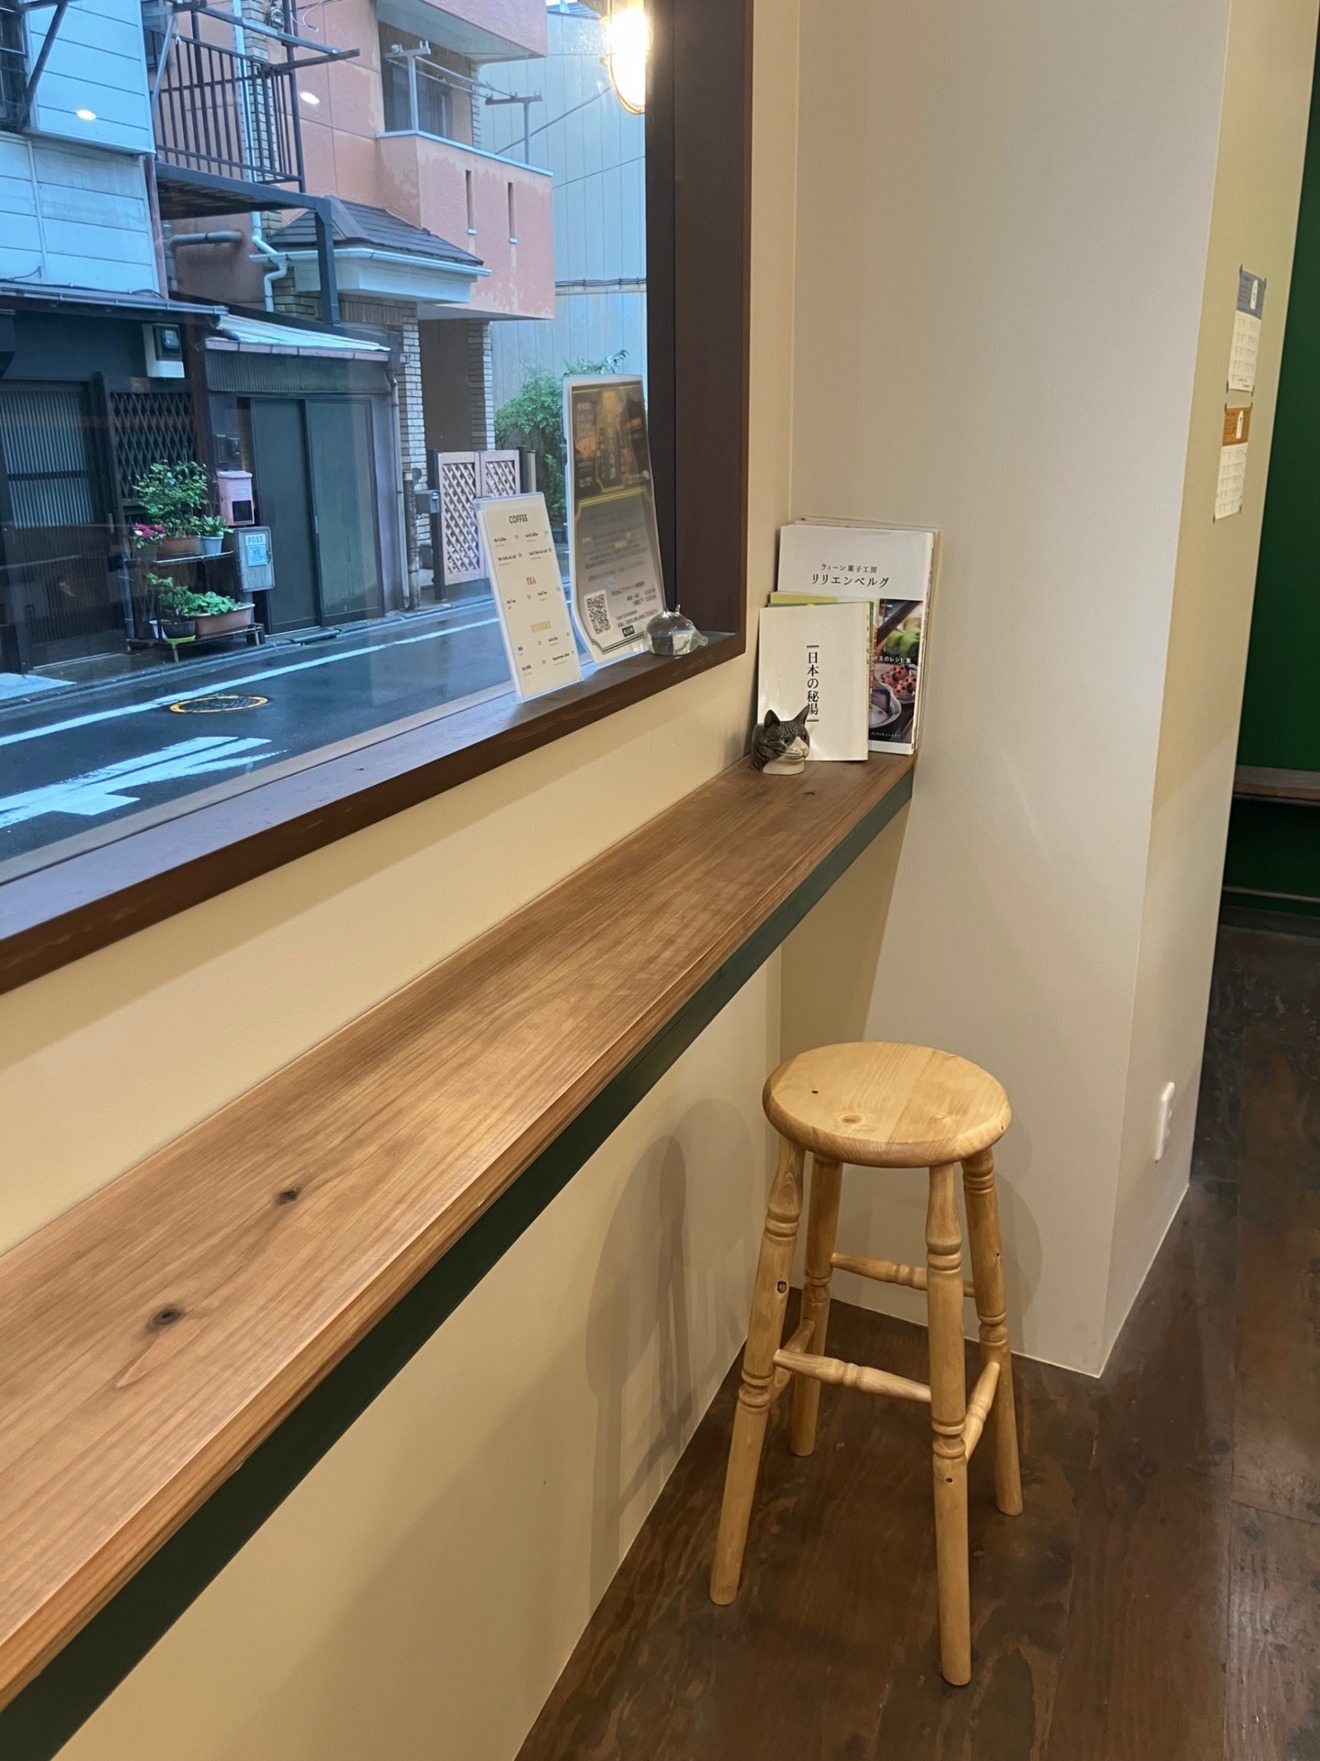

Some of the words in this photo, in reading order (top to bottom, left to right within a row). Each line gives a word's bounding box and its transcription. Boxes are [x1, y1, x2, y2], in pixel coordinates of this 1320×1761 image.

[509, 514, 528, 524] COFFEE
[247, 535, 263, 544] POST
[821, 563, 878, 574] ウィーン菓子工房
[811, 573, 890, 589] リリエンベルグ
